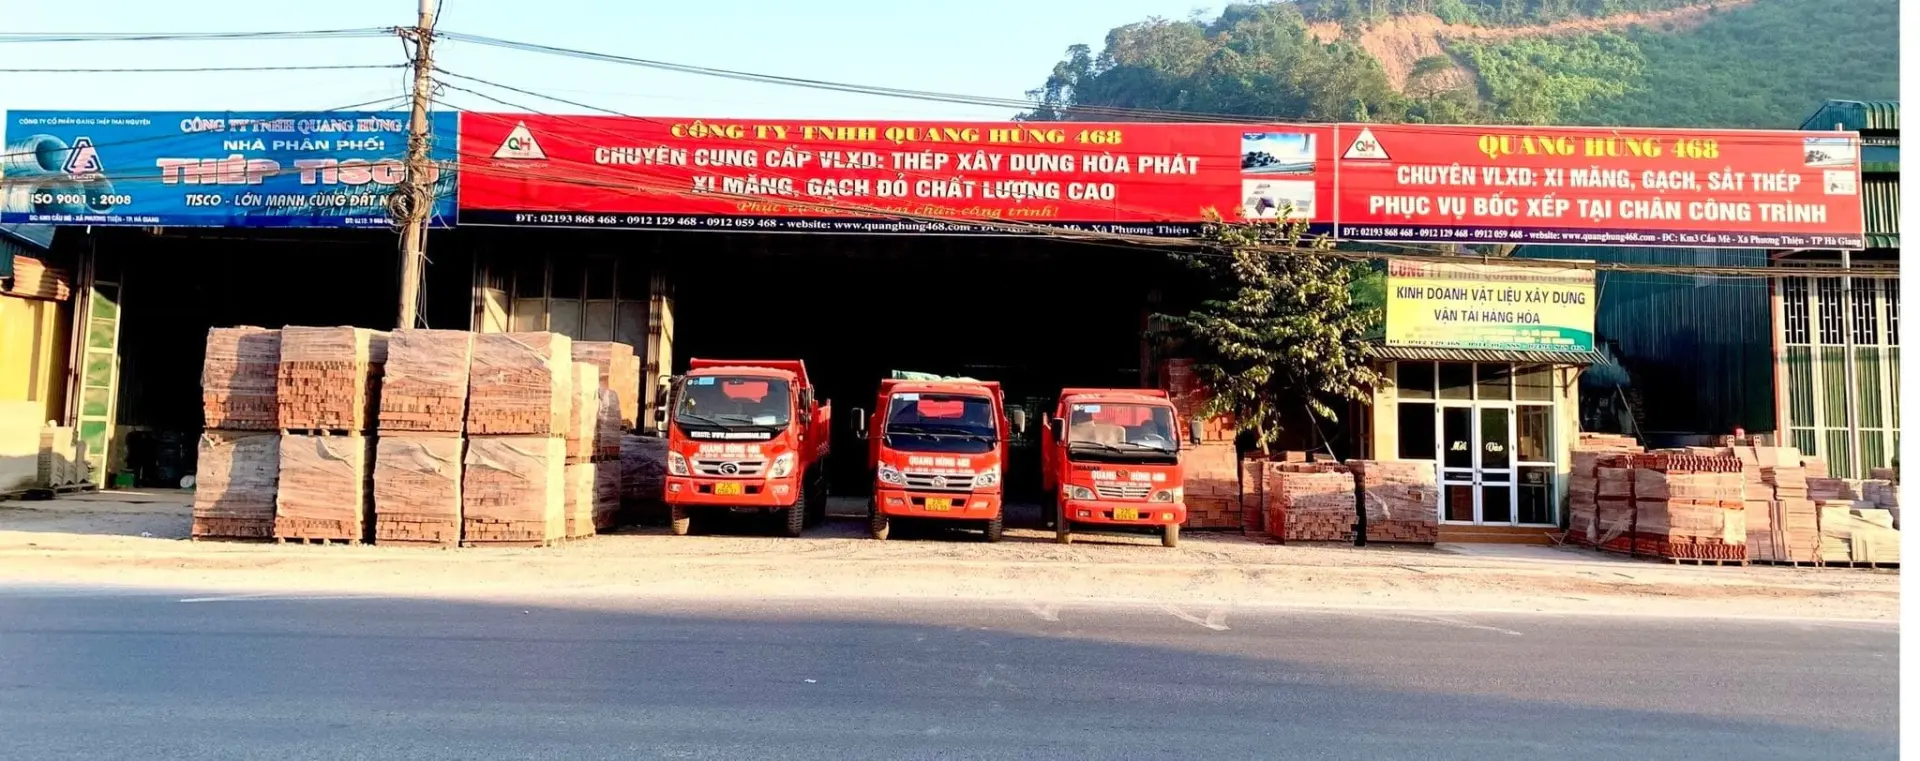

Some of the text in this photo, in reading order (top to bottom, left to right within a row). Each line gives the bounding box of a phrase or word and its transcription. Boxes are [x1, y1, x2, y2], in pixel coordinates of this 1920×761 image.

[181, 116, 225, 133] CÔNG
[228, 119, 250, 132] TY
[251, 119, 295, 133] TNHH
[297, 118, 354, 135] QUANG
[356, 115, 402, 133] HÙNG
[671, 119, 1122, 145] CÔNG TY TNHH QUANG HÙNG 468
[223, 136, 385, 151] NHÀ PHÂN PHỐI
[508, 137, 531, 151] QH
[1355, 140, 1375, 152] QH
[1478, 130, 1719, 160] QUANG HÙNG 468
[156, 154, 281, 185] THÉP
[594, 145, 1200, 176] CHUYÊN CUNG CẤP VLXD: THÉP XÂY DỰNG HÒA PHÁT
[1397, 162, 1801, 193] CHUYÊN VLXD: XI MĂNG, GẠCH, SẮT THÉP
[692, 173, 1116, 203] XI MĂNG, GẠCH ĐỎ CHẤT LƯỢNG CAO
[30, 193, 132, 205] ISO 9001 2008
[185, 194, 222, 207] TISCO
[234, 192, 262, 207] LỚN
[265, 194, 306, 210] MẠNH
[309, 191, 346, 207] CÙNG
[348, 191, 376, 207] ĐẤT
[1369, 191, 1827, 223] PHỤC VỤ BỐC XẾP TẠI CHÂN CÔNG TRÌNH
[515, 214, 538, 223] ĐT:
[540, 214, 572, 223] 02193
[575, 215, 595, 224] 868
[597, 216, 617, 224] 468
[626, 216, 653, 225] 0912
[656, 217, 675, 225] 129
[677, 217, 698, 226] 468
[706, 218, 733, 227] 0912
[735, 218, 755, 227] 059
[757, 219, 777, 228] 468
[787, 220, 831, 230] website:
[834, 221, 971, 232] www.quanghung468.com
[1092, 225, 1107, 234] Xã
[1110, 225, 1153, 235] Phương
[1156, 225, 1190, 235] Thiện
[1343, 227, 1360, 237] ĐT:
[1360, 228, 1383, 238] 02193
[1384, 229, 1399, 238] 868
[1399, 229, 1414, 238] 468
[1420, 229, 1439, 239] 0912
[1440, 229, 1453, 239] 129
[1454, 230, 1469, 239] 468
[1475, 230, 1493, 240] 0912
[1494, 230, 1508, 240] 059
[1509, 231, 1523, 240] 468
[1530, 231, 1561, 240] website:
[1562, 232, 1657, 242] www.quanghung468.com
[1662, 233, 1679, 242] ĐC:
[1680, 233, 1698, 243] Km3
[1750, 235, 1780, 246] Phương
[1811, 237, 1823, 245] TP
[1827, 236, 1837, 245] Hà
[1838, 237, 1862, 247] Giang
[1397, 285, 1586, 308] KINH DOANH VẬT LIỆU XÂY DỰNG
[1434, 306, 1458, 325] VẬN
[1461, 305, 1479, 322] TẢI
[1482, 309, 1513, 323] HÀNG
[1485, 441, 1503, 452] Vào
[909, 456, 934, 466] QUANG
